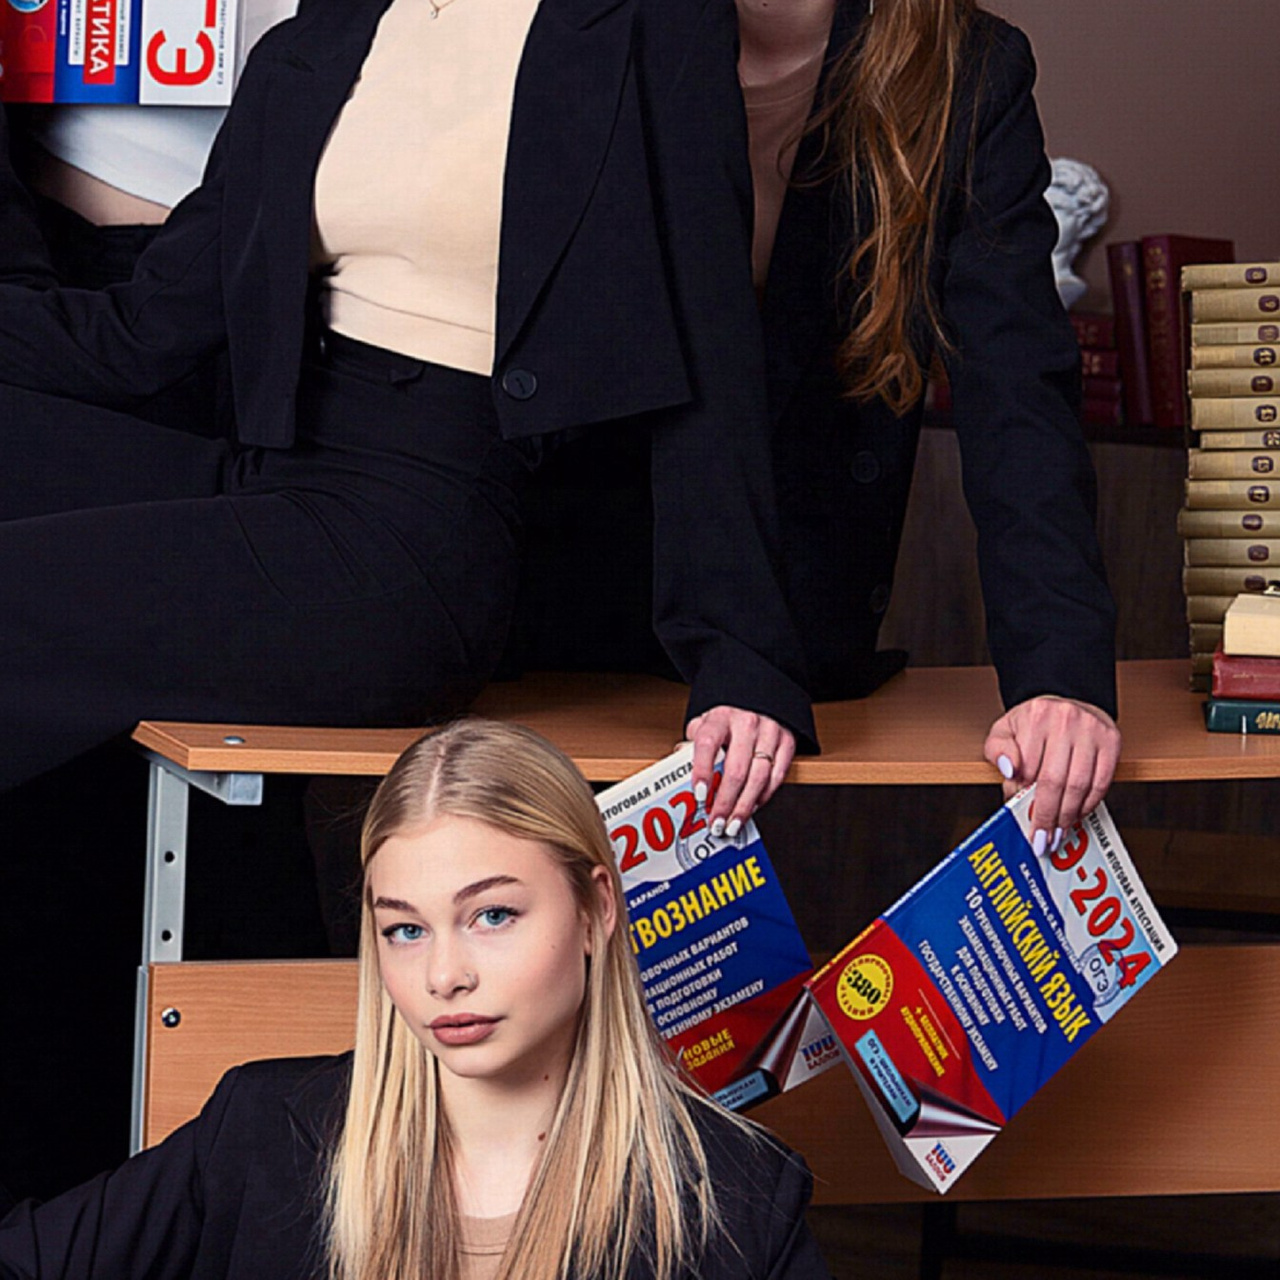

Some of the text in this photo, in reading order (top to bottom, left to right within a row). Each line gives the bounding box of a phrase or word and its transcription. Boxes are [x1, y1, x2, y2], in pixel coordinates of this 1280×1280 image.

[653, 760, 694, 792] АТТЕСТА
[606, 770, 725, 874] 202
[621, 855, 766, 954] ТВОЗНАНИЕ
[1027, 788, 1152, 991] Э-2024
[639, 915, 749, 983] ОВОЧНЫХ ВАРИАНТОВ
[966, 841, 1091, 1042] АНГЛИЙСКИЙ ЯЗЫК
[1129, 896, 1165, 952] АТТЕСТАЦИЯ
[642, 940, 738, 1000] АЦИОННЫХ РАБОТ
[654, 967, 723, 1010] ПОДГОТОВКИ
[955, 945, 1006, 1024] ДЛЯ ПОДГОТОВКИ
[957, 913, 1028, 1031] ЭКЗАМЕНАЦИОННЫХ РАБОТ
[964, 885, 1047, 1034] 10 ТРЕНИРОВОЧНЫХ ВАРИАНТОВ
[1088, 956, 1109, 993] ОГЭ
[656, 986, 717, 1027] ОСНОВНОМУ
[658, 978, 764, 1039] ТВЕННОМУ ЭКЗАМЕНУ
[845, 968, 882, 1015] 380
[917, 938, 998, 1071] ГОСУДАРСТВЕННОМУ ЭКЗАМЕНУ
[950, 964, 990, 1026] К ОСНОВНОМУ
[679, 1028, 731, 1060] НОВЫЕ
[930, 1142, 956, 1174] 100
